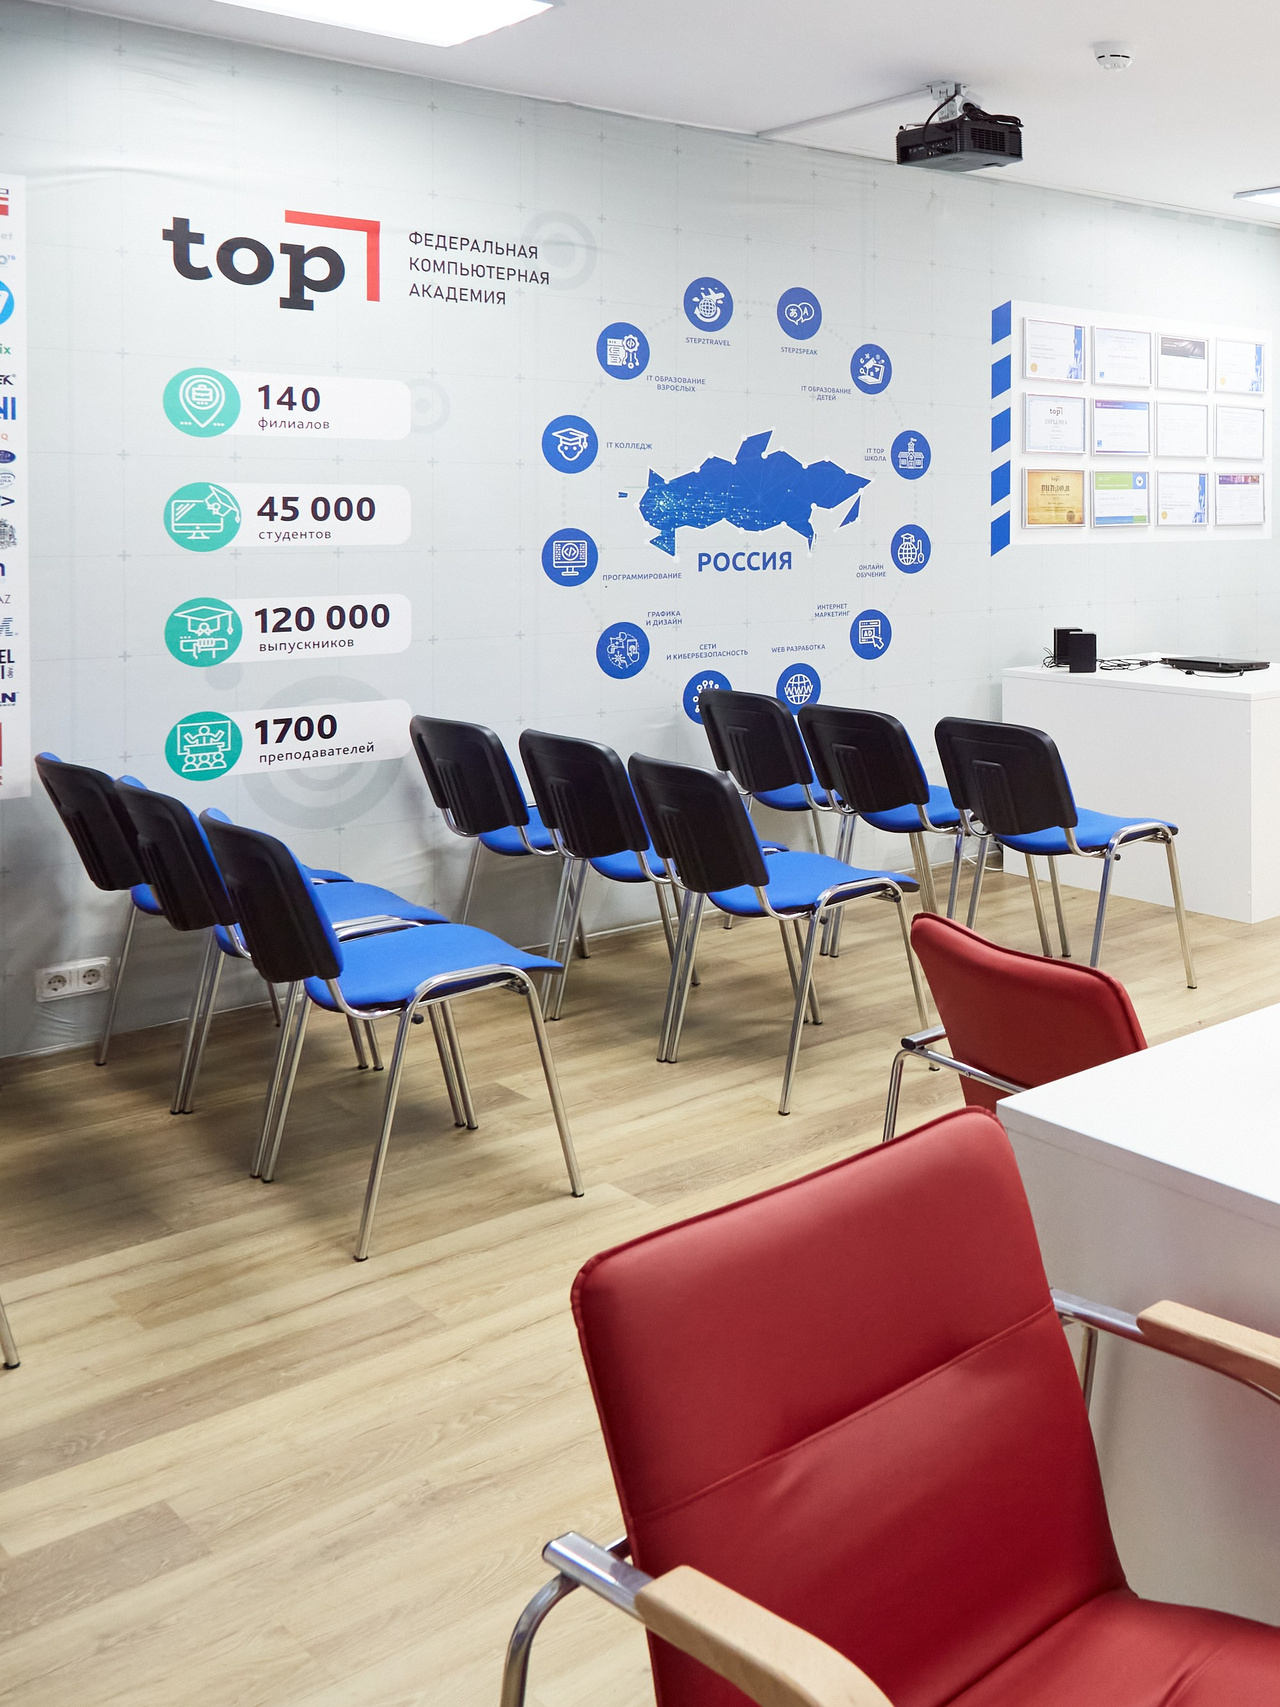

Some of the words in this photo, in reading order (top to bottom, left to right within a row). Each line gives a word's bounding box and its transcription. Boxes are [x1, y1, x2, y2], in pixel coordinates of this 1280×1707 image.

[409, 231, 539, 260] ФЕДЕРАЛЬНАЯ
[162, 216, 345, 311] top
[409, 257, 550, 286] КОМПЬЮТЕРНАЯ
[409, 283, 507, 306] АКАДЕМИЯ
[685, 336, 731, 347] STEP2TRAVEL
[781, 346, 818, 356] STEP2SPEAK
[654, 375, 706, 385] ОБРАЗОВАНИЕ
[657, 383, 696, 393] ВЗРОСЛЫХ
[808, 386, 852, 395] ОБРАЗОВАНИЕ
[257, 384, 321, 412] 140
[258, 417, 330, 431] филиалов
[614, 442, 653, 451] КОЛЛЕДЖ
[257, 496, 300, 522] 45
[310, 496, 376, 522] 000
[258, 530, 332, 542] студентов
[698, 551, 792, 572] РОССИЯ
[859, 563, 884, 571] ОНЛАЙН
[602, 572, 682, 581] ПРОГРАММИРОВАНИЕ
[254, 605, 316, 634] 120
[326, 603, 391, 631] 000
[647, 610, 681, 618] ГРАФИКА
[652, 617, 683, 627] ДИЗАЙН
[259, 638, 355, 653] выпускников
[787, 644, 826, 653] РАЗРАБОТКА
[673, 650, 749, 660] КИБЕРБЕЗОПАСНОСТЬ
[254, 714, 338, 745] 1700
[259, 742, 375, 765] преподавателей
